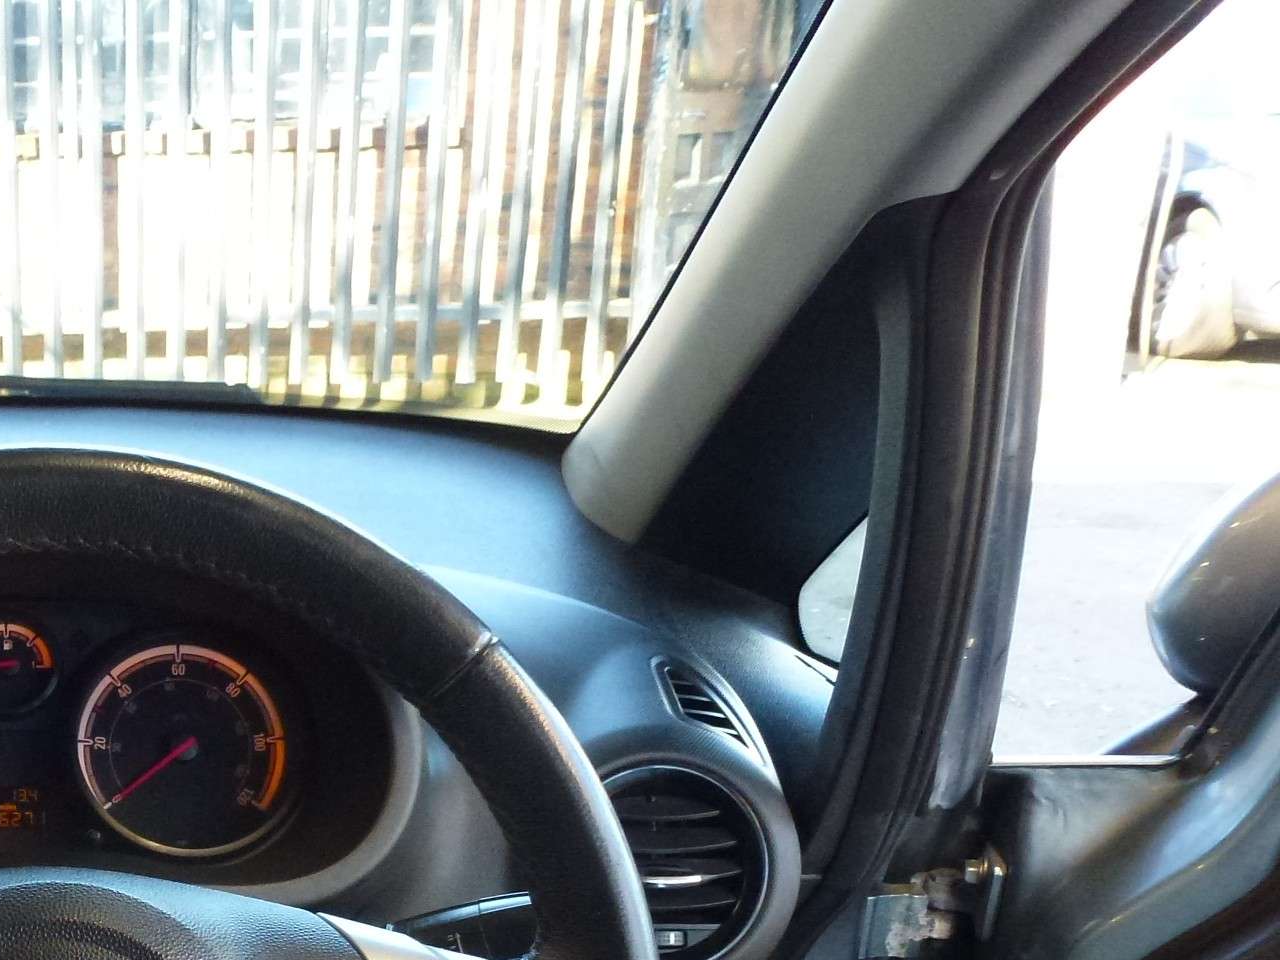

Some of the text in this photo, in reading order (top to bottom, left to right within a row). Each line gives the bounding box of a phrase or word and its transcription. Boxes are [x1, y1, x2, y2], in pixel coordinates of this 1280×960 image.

[171, 663, 185, 676] 60
[224, 682, 241, 698] 80
[94, 735, 107, 750] 20
